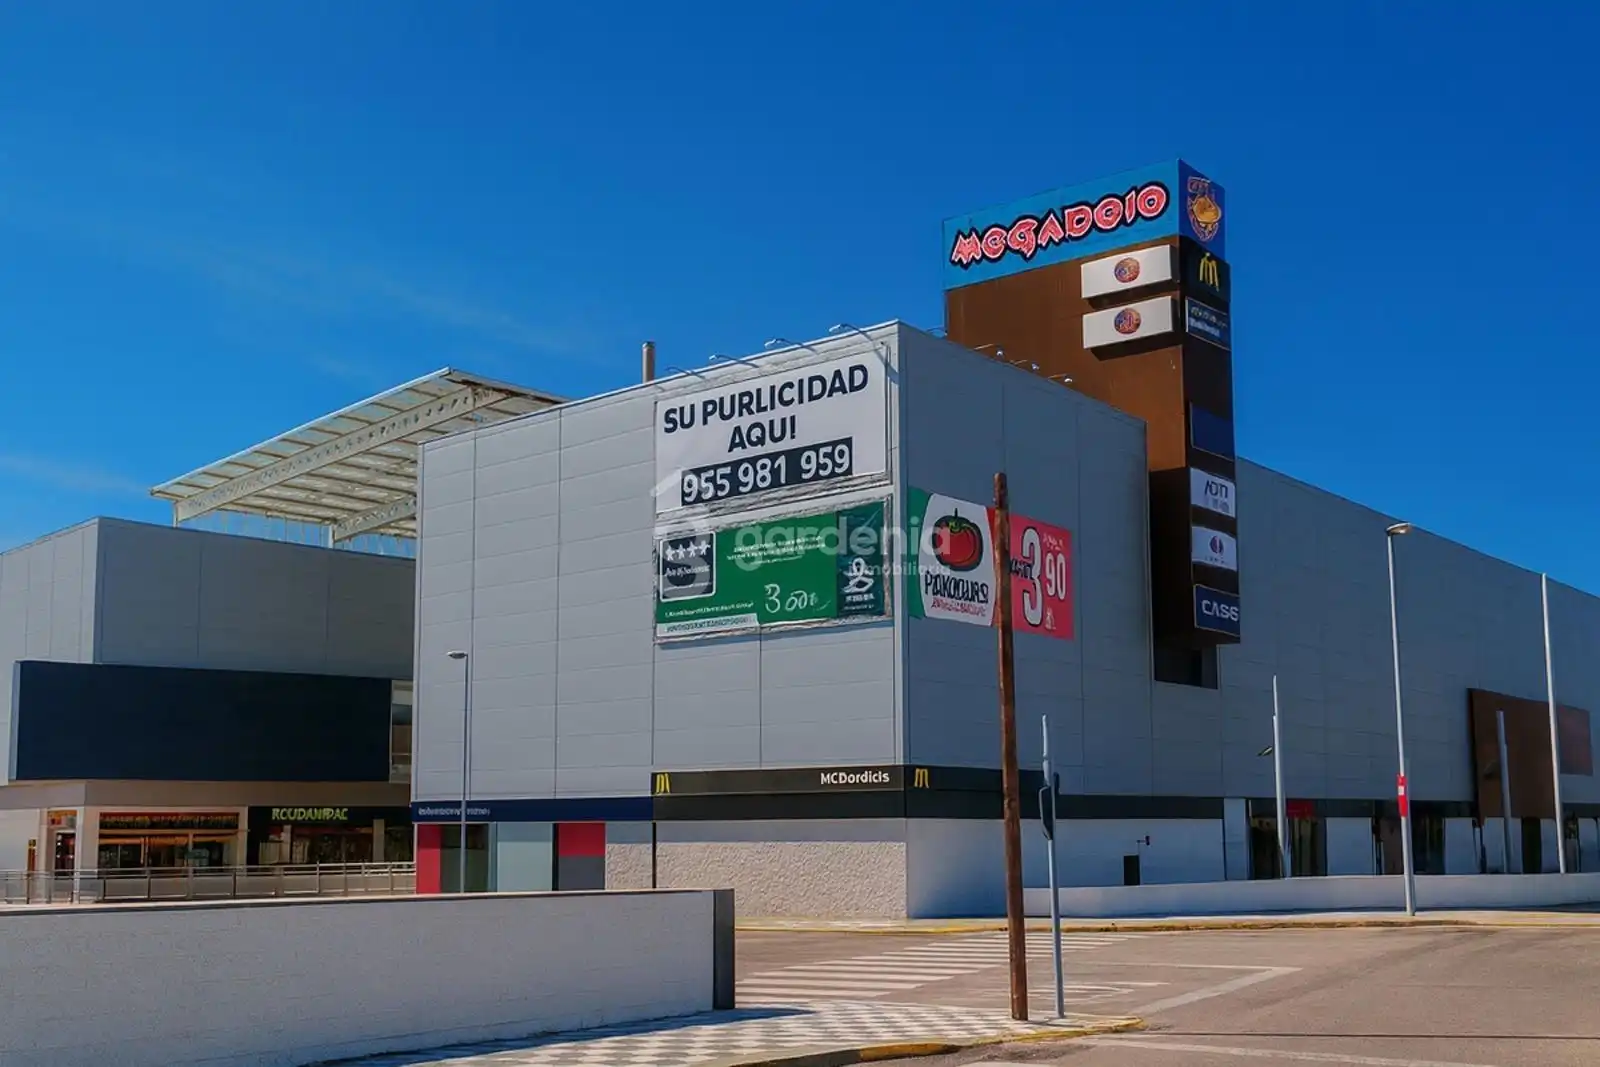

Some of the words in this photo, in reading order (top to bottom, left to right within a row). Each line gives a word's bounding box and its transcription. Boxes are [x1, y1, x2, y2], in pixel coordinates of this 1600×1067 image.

[663, 404, 696, 433] SU
[702, 364, 869, 426] PURLICIDAD
[683, 467, 731, 502] 955
[737, 455, 787, 493] 981
[801, 444, 850, 480] 959
